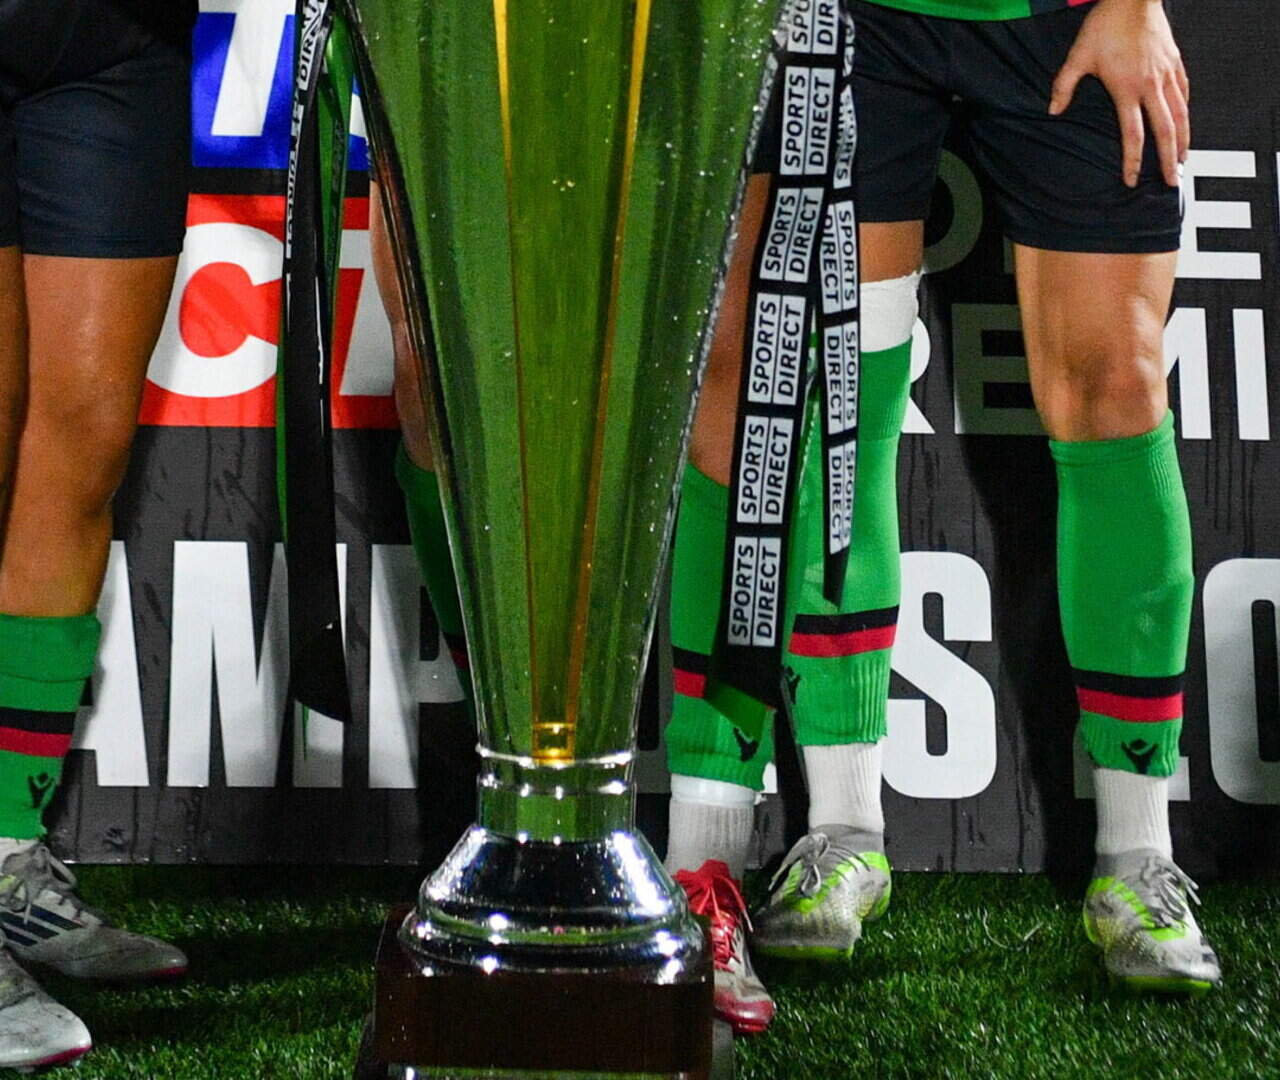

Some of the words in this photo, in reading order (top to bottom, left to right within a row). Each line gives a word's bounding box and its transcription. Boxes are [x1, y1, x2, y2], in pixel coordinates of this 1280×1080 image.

[785, 74, 806, 168] SPORTS
[809, 76, 831, 167] DIRECT
[766, 194, 796, 271] SPORTS
[789, 195, 819, 274] DIRECT
[823, 213, 839, 304] DIRECT
[839, 209, 855, 301] SPORTS
[753, 300, 777, 395] SPORTS
[777, 304, 802, 398] DIRECT
[827, 334, 842, 424] DIRECT
[844, 330, 856, 422] SPORTS
[741, 423, 766, 516] SPORTS
[765, 425, 790, 516] DIRECT
[831, 455, 842, 542] DIRECT
[731, 544, 754, 638] SPORTS
[756, 546, 778, 639] DIRECT
